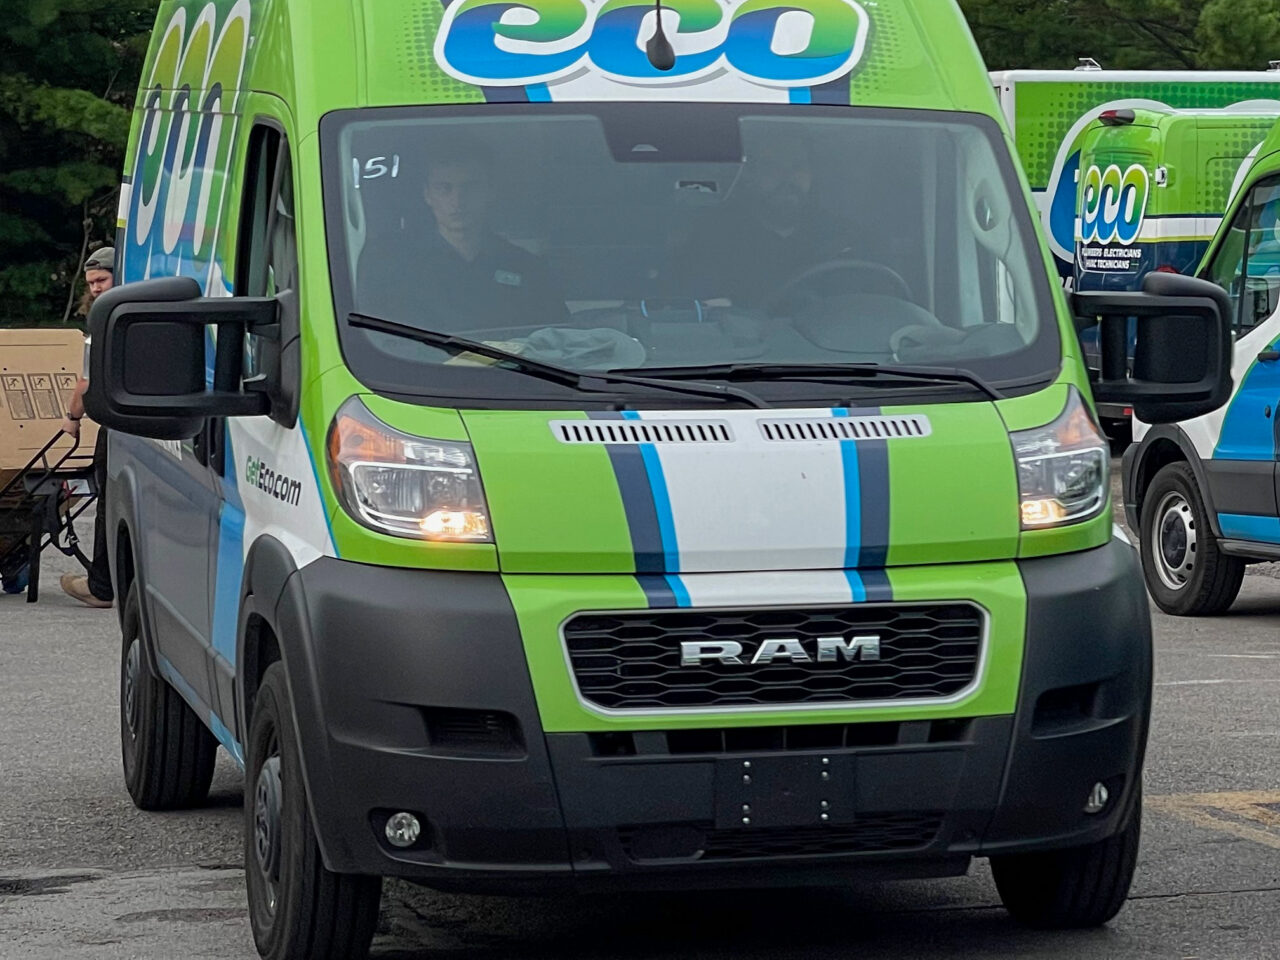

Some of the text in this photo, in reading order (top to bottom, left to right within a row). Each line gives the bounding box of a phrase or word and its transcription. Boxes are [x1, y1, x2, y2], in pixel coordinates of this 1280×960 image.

[352, 154, 400, 189] 151
[1081, 164, 1149, 245] eco
[245, 455, 302, 507] GetEco.com
[680, 635, 881, 666] RAM
